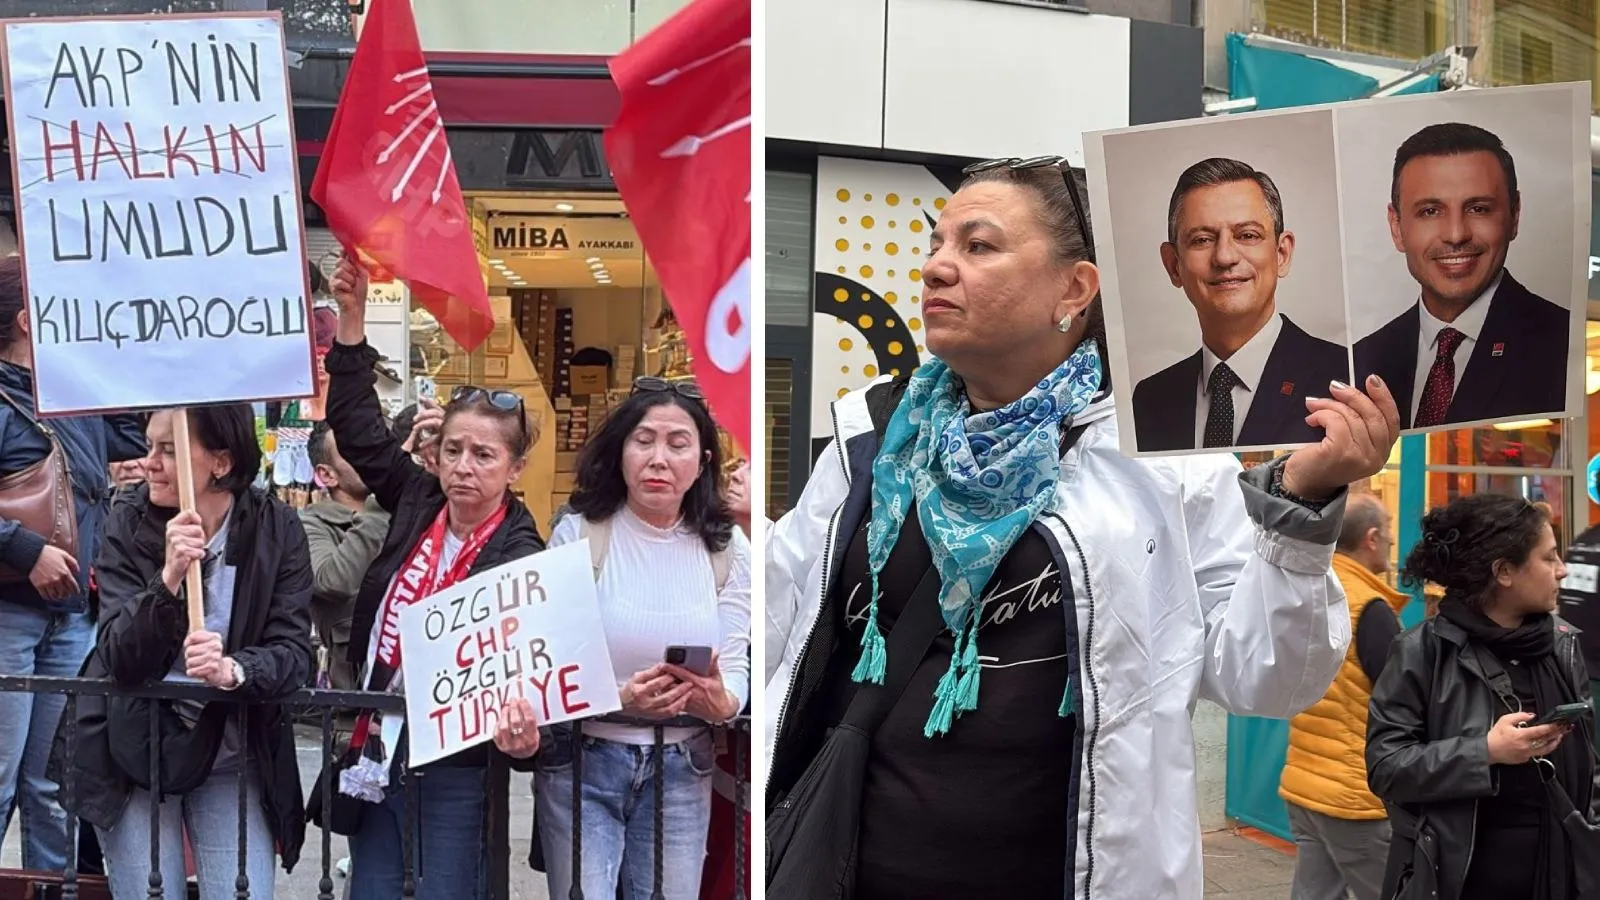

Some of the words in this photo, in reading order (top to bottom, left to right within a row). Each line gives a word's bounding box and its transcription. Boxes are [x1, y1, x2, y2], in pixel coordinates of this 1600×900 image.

[42, 119, 266, 182] HALKIN
[48, 194, 288, 262] UMUDU
[493, 222, 569, 249] MİBA
[34, 295, 305, 349] KILIÇDAROĞLU
[425, 570, 547, 640] ÖZGÜR
[433, 638, 553, 705] ÖZGÜR
[456, 616, 519, 669] CHP
